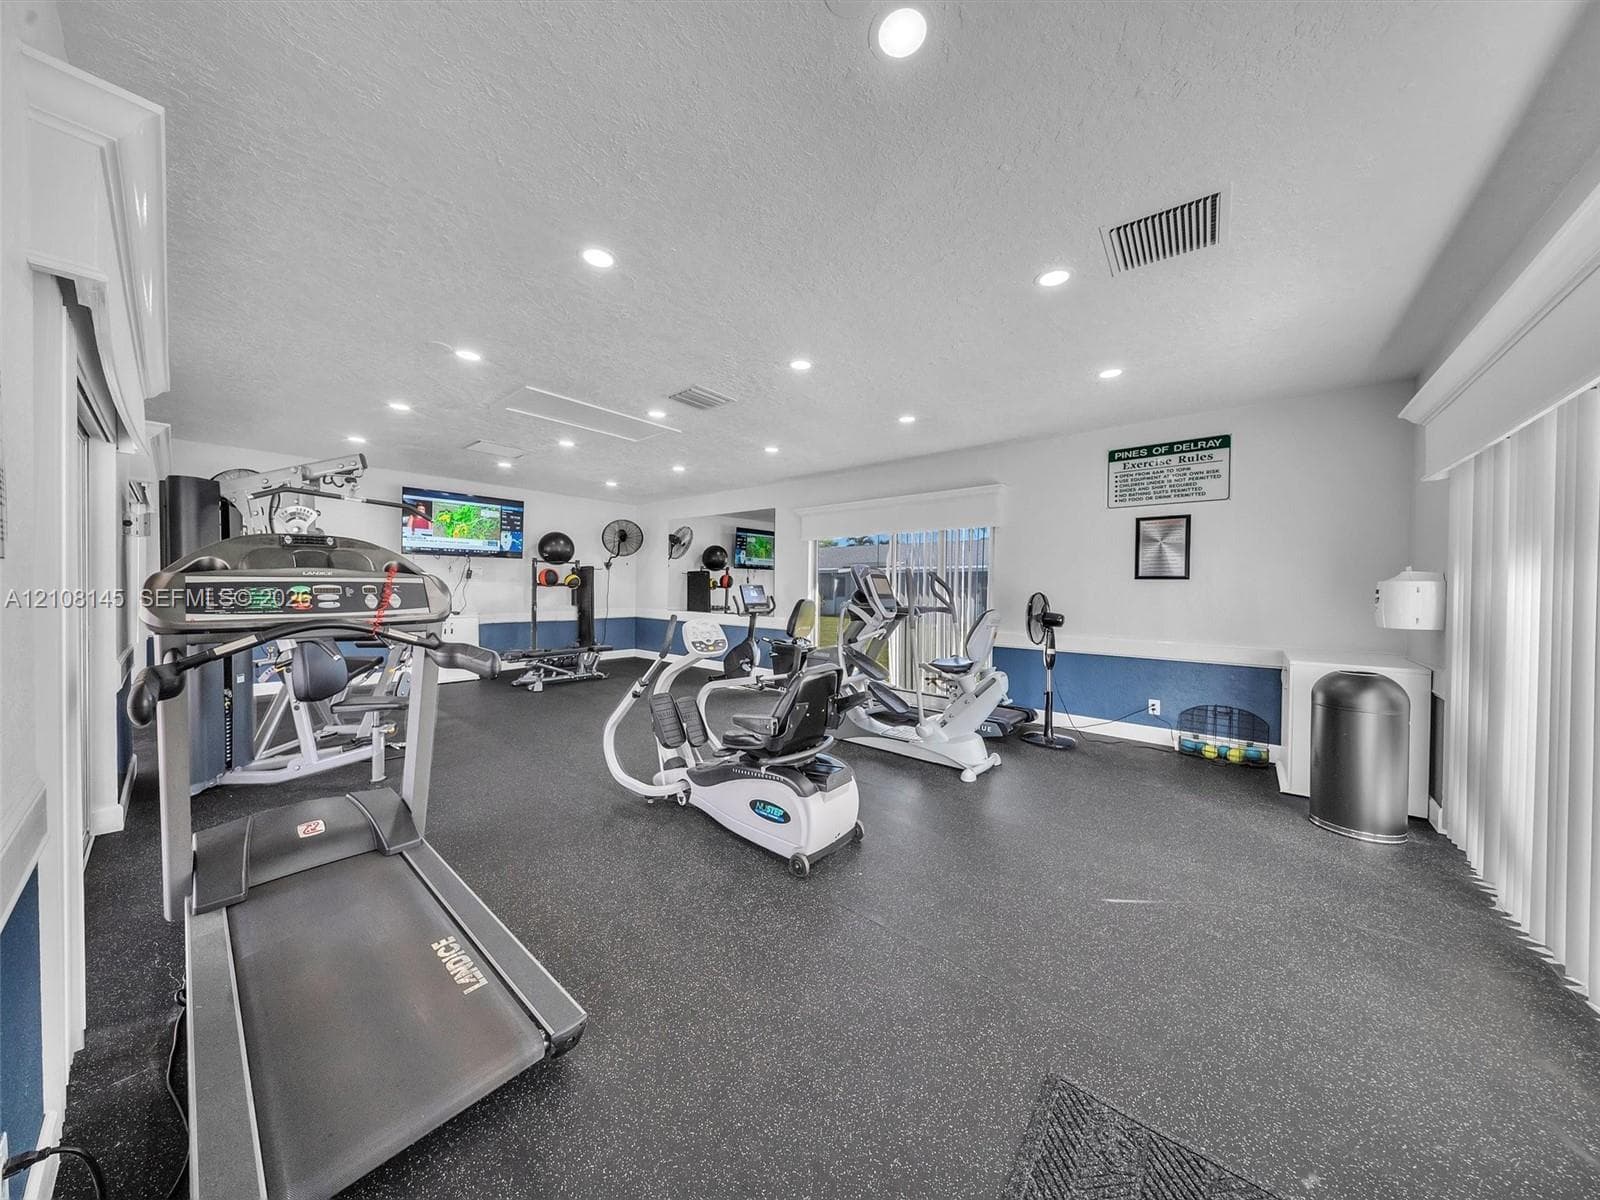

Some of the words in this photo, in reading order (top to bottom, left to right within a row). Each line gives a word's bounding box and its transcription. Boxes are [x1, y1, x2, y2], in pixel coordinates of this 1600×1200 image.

[1114, 448, 1148, 460] PINES
[1152, 445, 1169, 455] OF
[1173, 438, 1223, 452] DELRAY
[1122, 458, 1172, 470] Exercise
[1178, 453, 1214, 464] Rules
[431, 935, 488, 995] LANDICE
